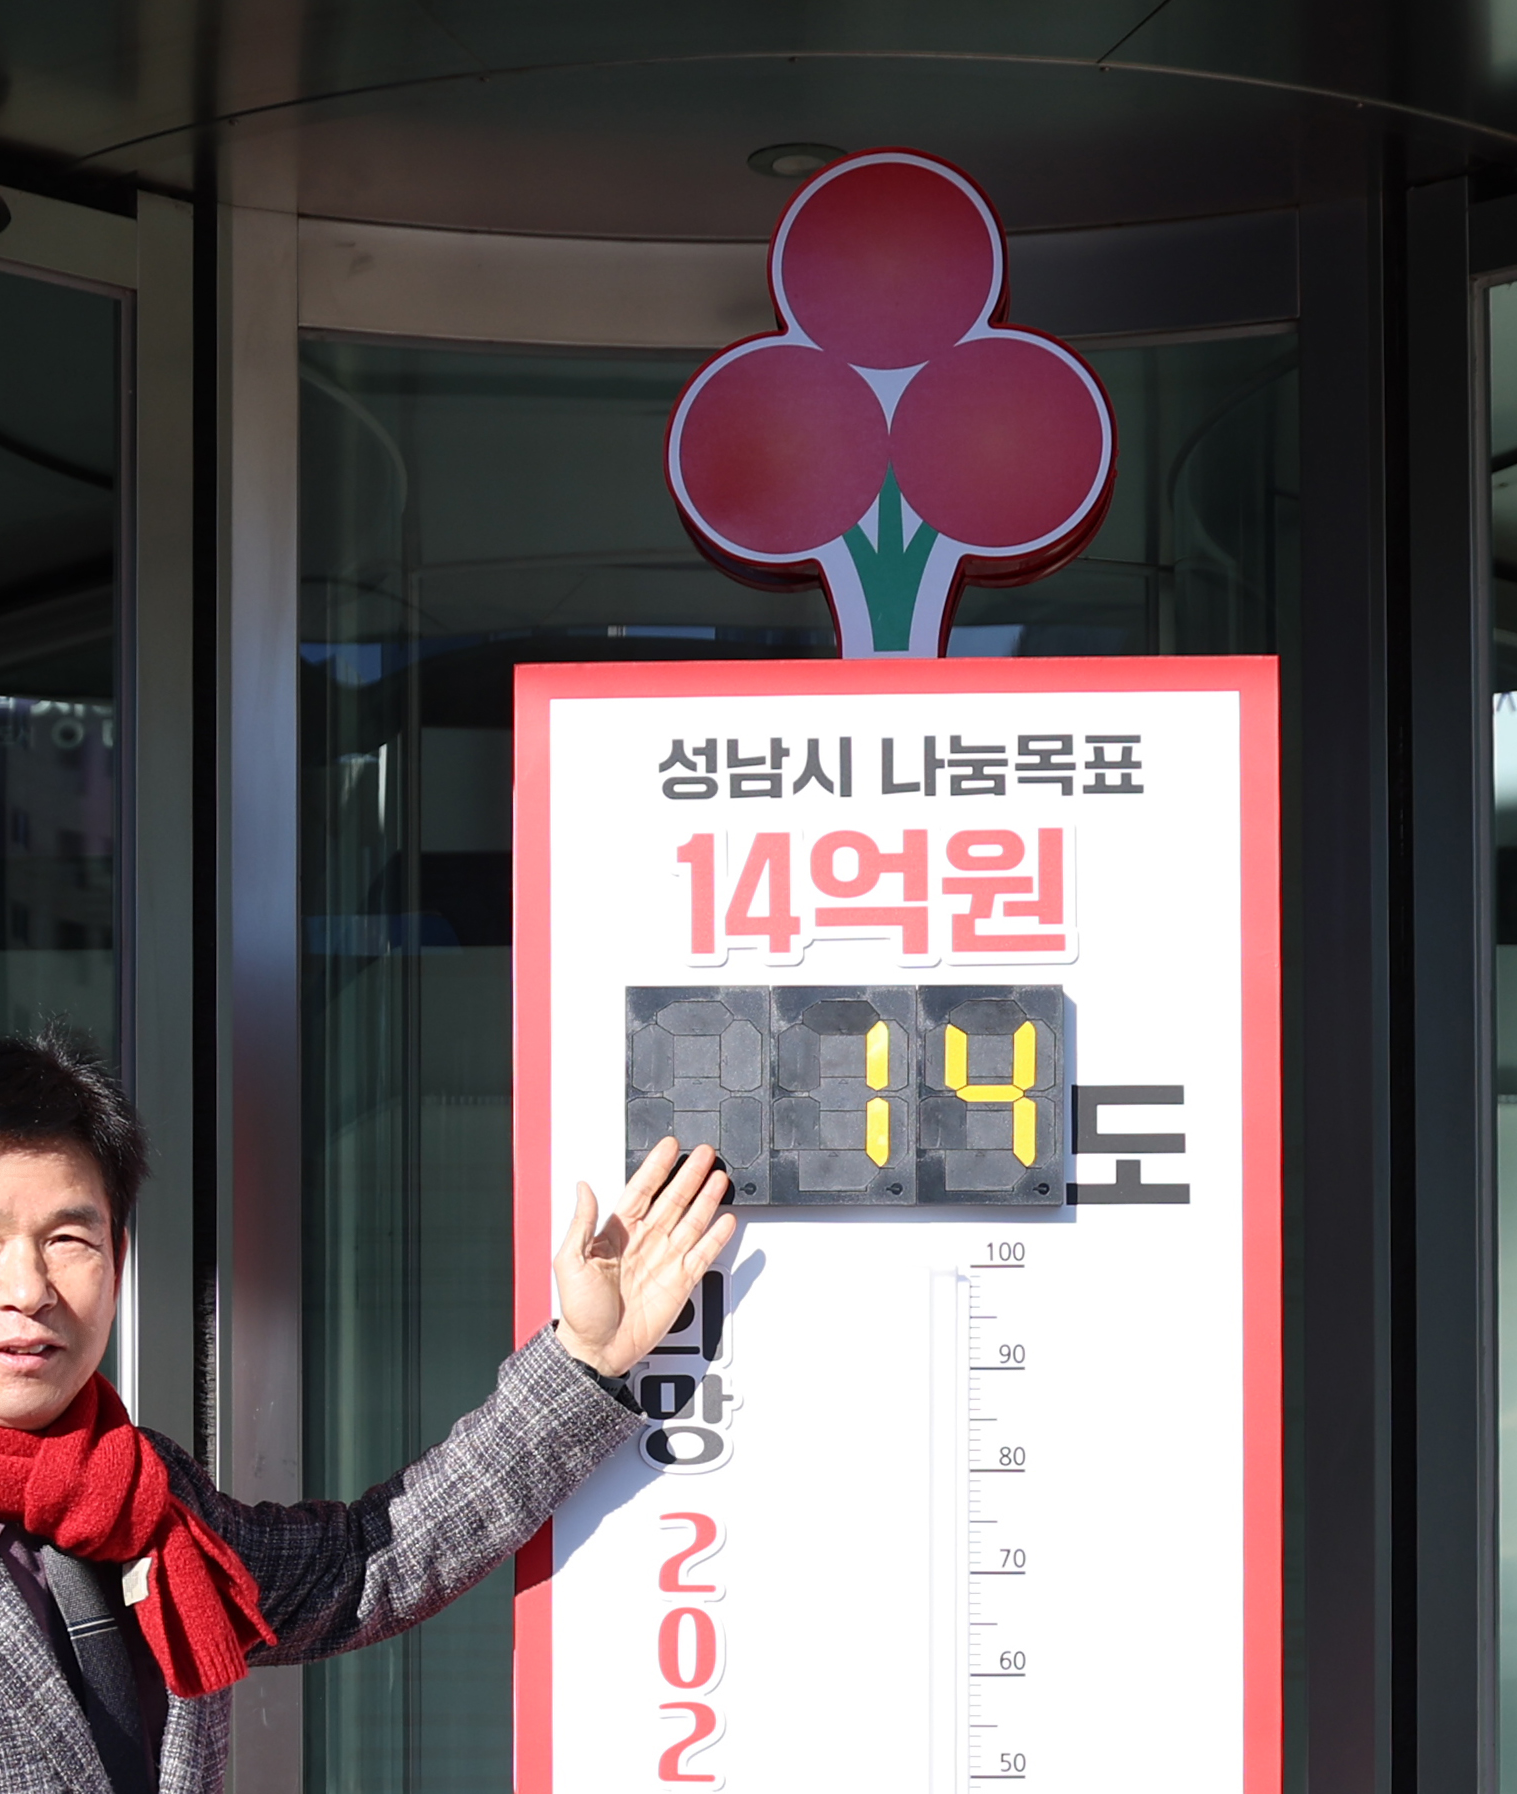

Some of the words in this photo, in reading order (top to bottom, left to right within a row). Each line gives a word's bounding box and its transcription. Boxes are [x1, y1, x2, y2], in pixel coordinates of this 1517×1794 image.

[658, 736, 853, 801] 성남시
[881, 733, 1145, 797] 나눔목표
[676, 827, 1067, 955] 14억원
[865, 1020, 1037, 1167] 14
[1066, 1085, 1191, 1205] 도
[987, 1241, 1026, 1262] 100
[998, 1343, 1026, 1364] 90
[998, 1446, 1026, 1467] 80
[999, 1548, 1026, 1569] 70
[999, 1650, 1026, 1671] 60
[1000, 1752, 1027, 1773] 50
